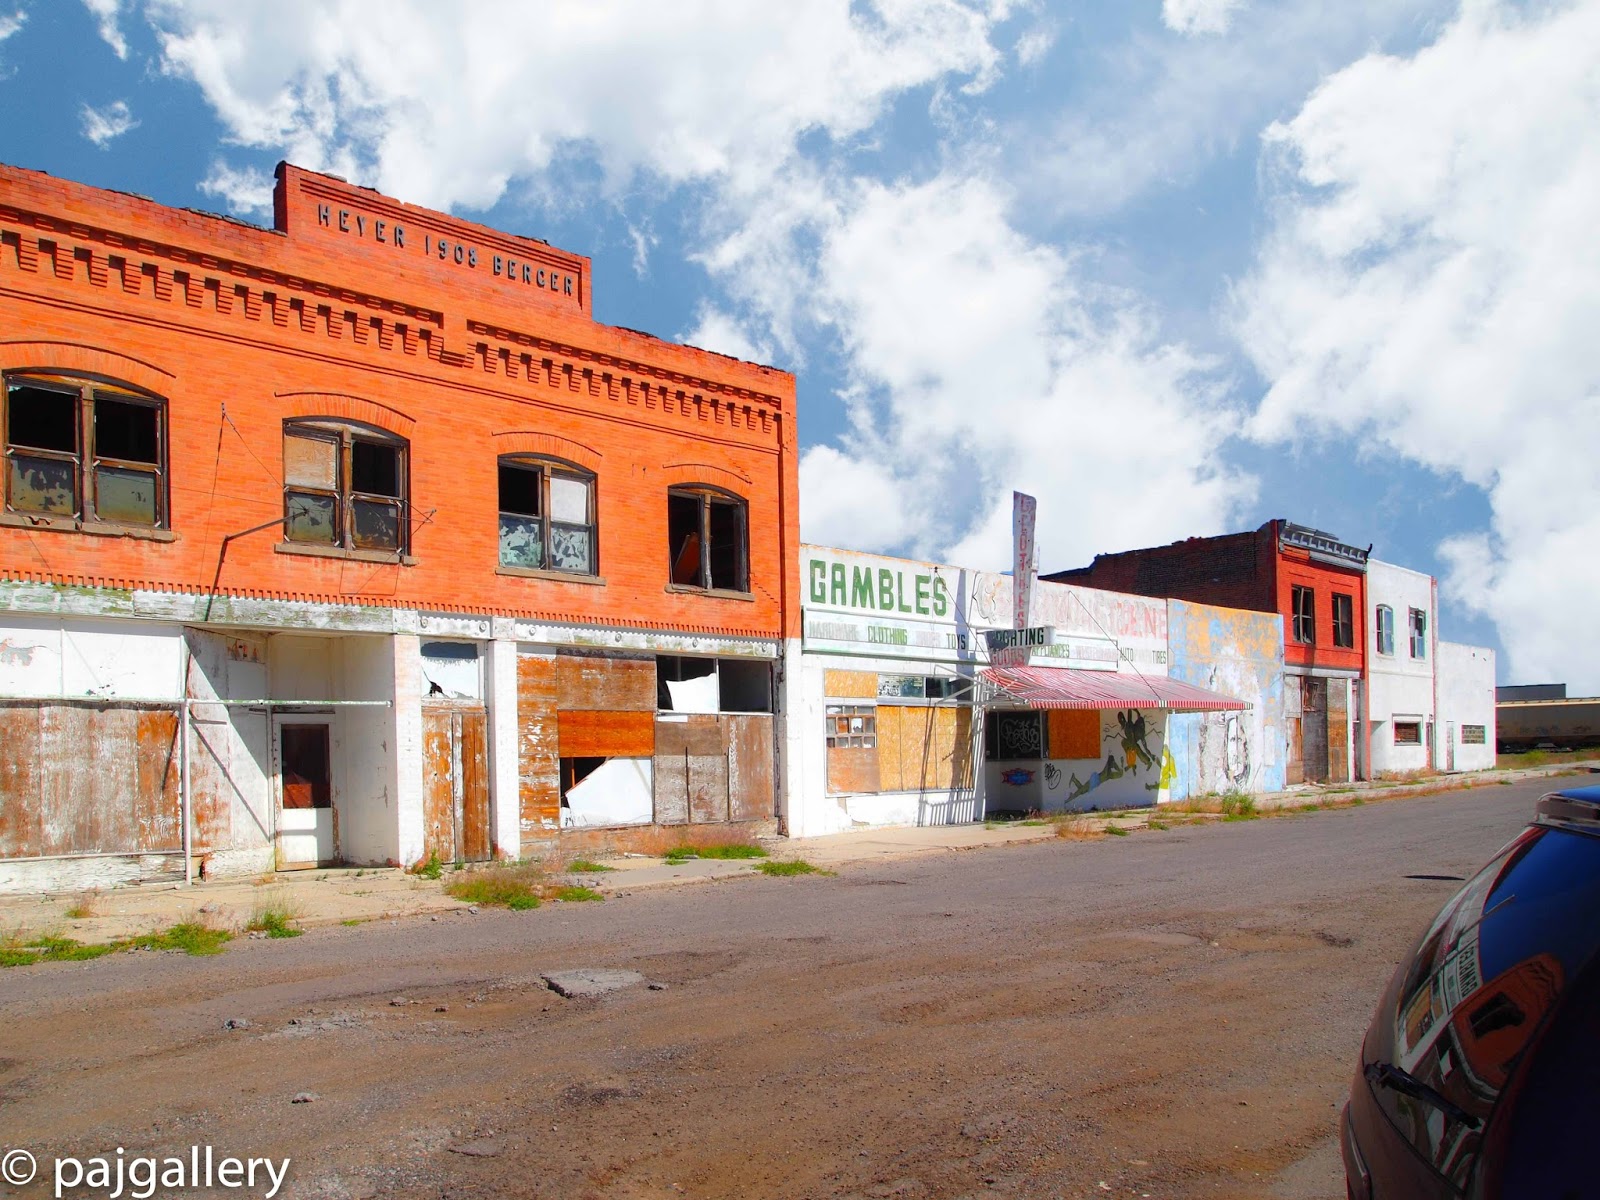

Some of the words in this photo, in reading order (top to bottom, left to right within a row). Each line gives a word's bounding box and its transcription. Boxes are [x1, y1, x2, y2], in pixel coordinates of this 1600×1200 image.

[317, 203, 405, 248] HEYER
[425, 235, 478, 268] 1908
[810, 559, 947, 617] GAMBLES
[867, 625, 908, 646] CLOTHING
[946, 632, 966, 650] TOYS
[989, 628, 1044, 646] PORTING
[1120, 646, 1134, 662] AUTO
[1152, 650, 1167, 665] TIRES
